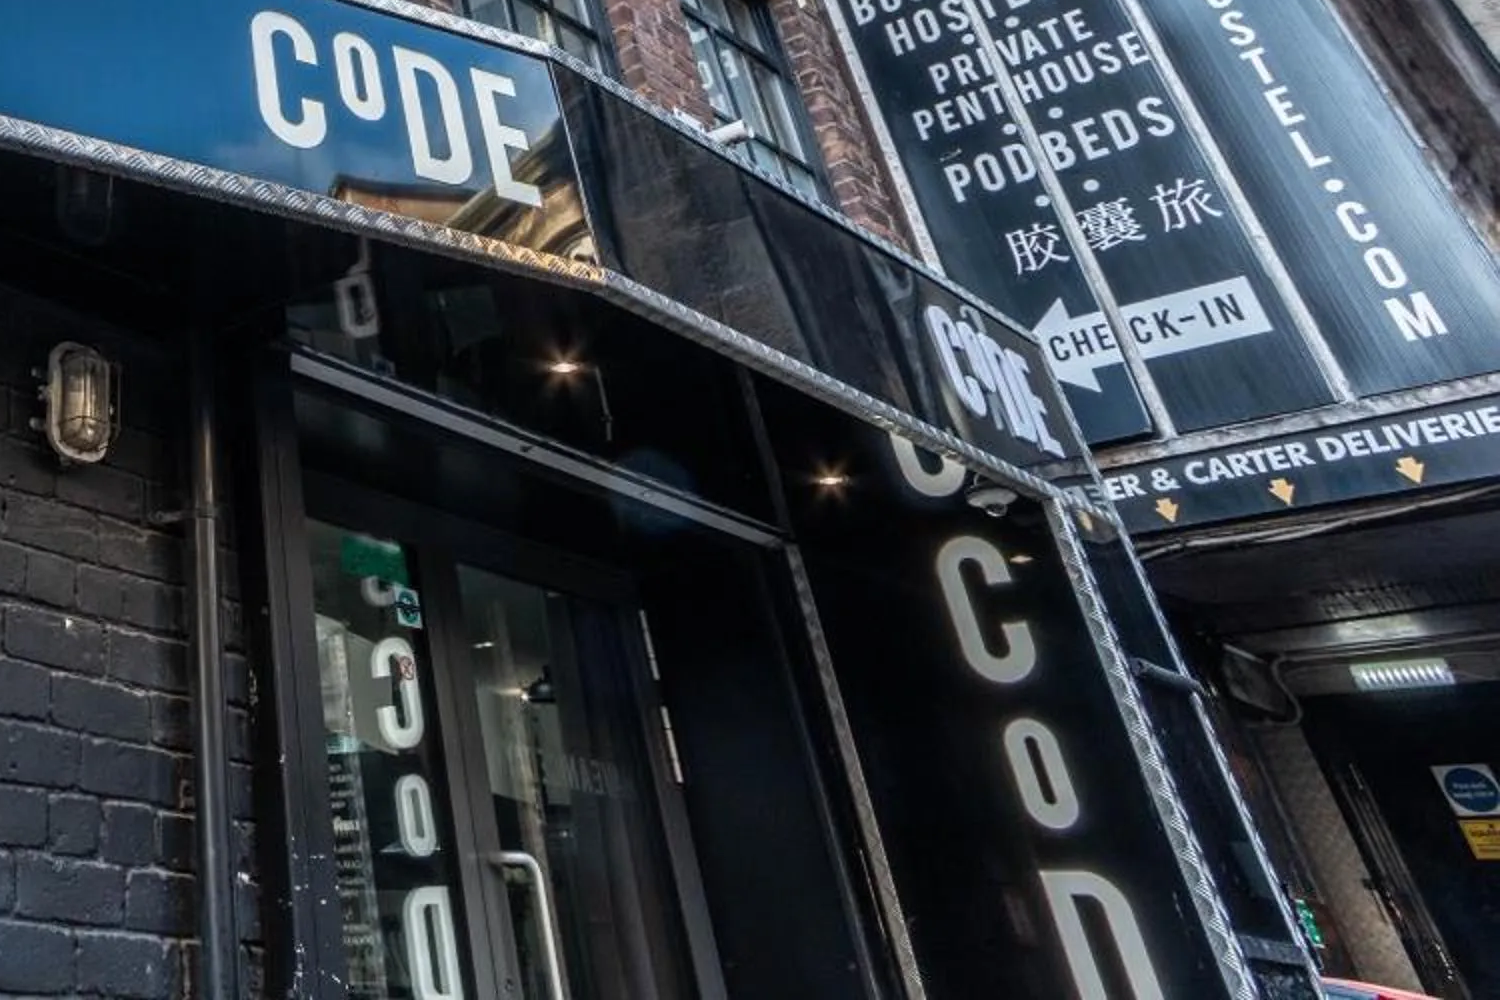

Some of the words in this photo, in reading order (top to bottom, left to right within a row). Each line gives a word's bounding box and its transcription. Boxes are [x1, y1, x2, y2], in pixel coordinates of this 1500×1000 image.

[928, 7, 1094, 95] PRIVATE
[1050, 292, 1247, 363] CHECK-IN
[1150, 467, 1182, 492] &
[1184, 440, 1317, 484] CARTER
